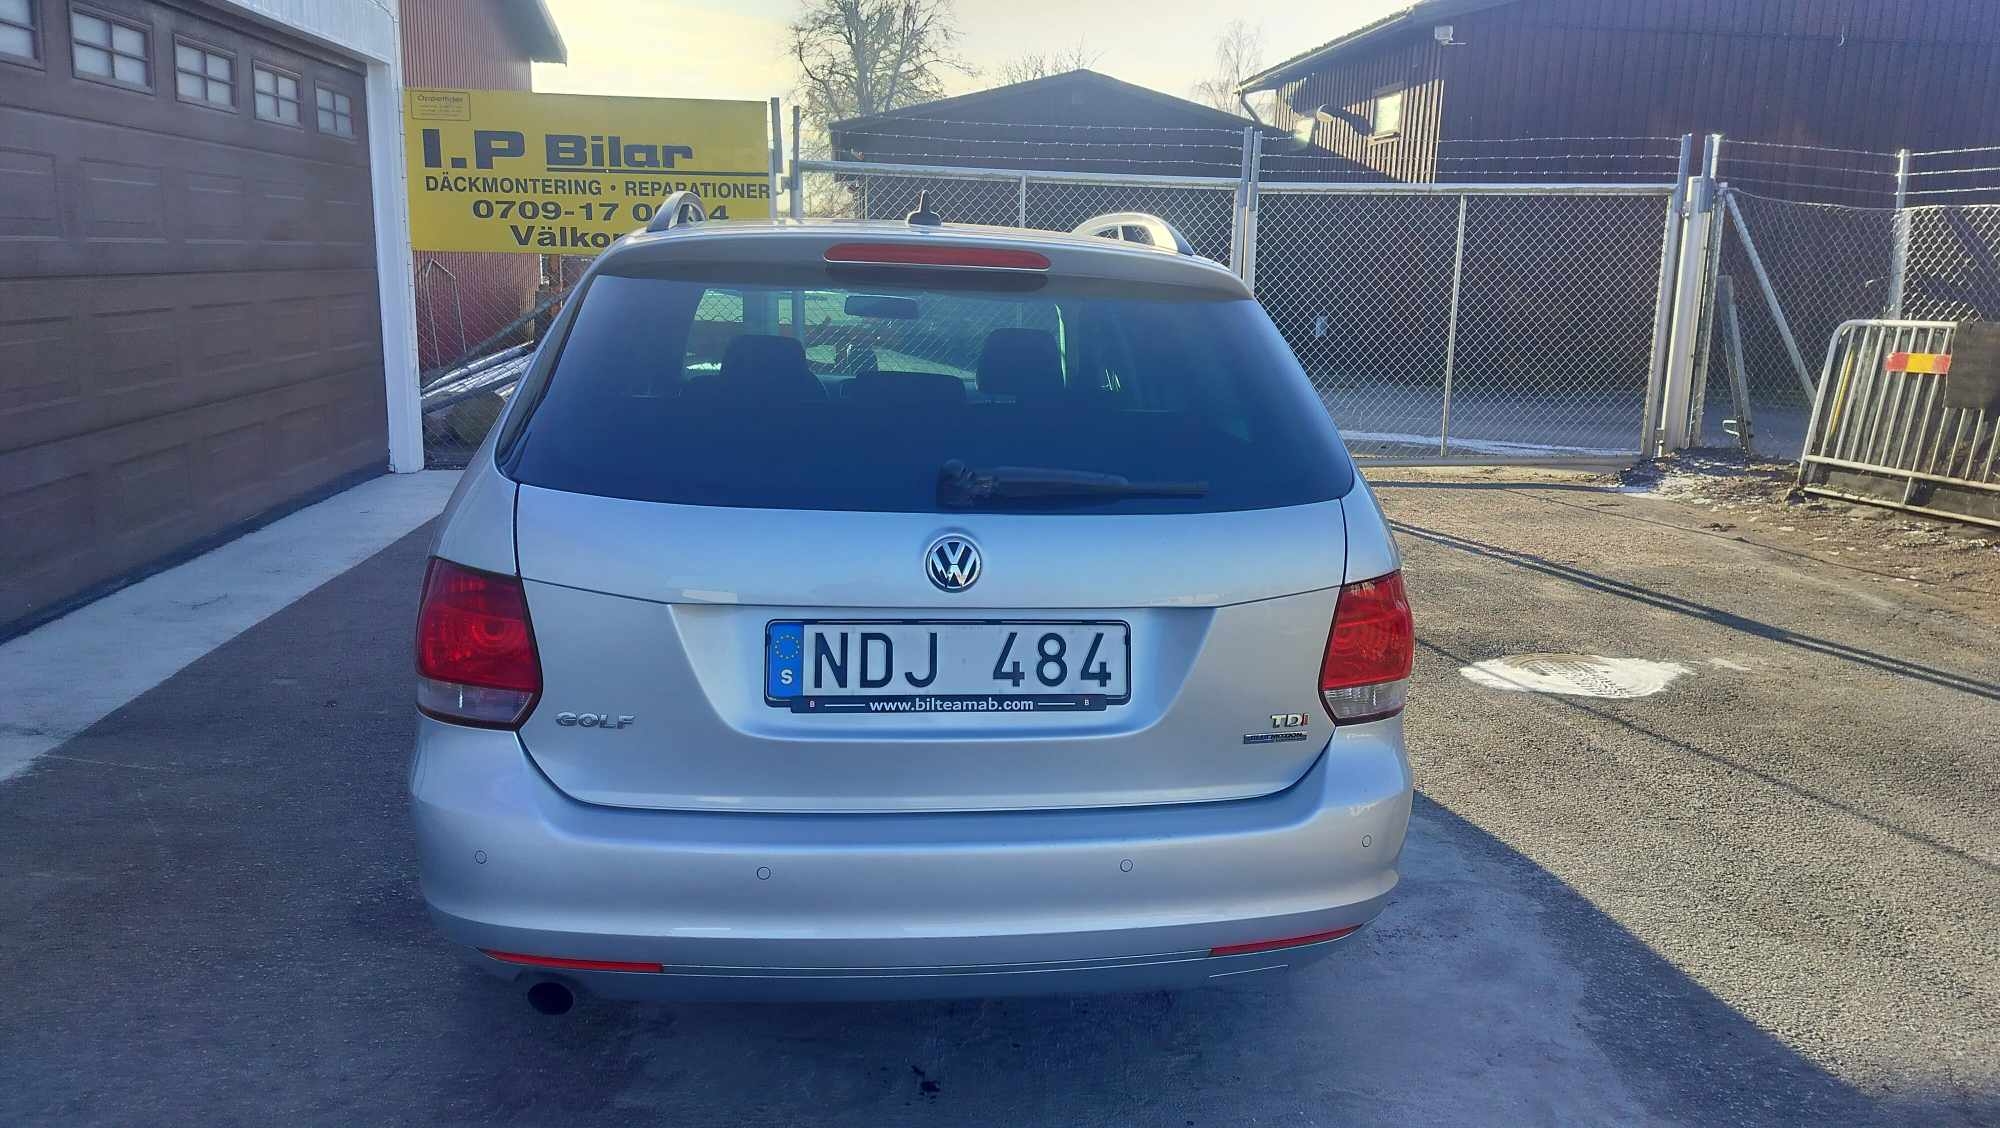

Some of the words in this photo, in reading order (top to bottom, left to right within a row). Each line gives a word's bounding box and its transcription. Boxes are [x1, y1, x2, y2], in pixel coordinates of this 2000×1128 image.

[422, 128, 525, 169] I.P
[545, 134, 693, 168] Bilar
[425, 171, 602, 196] DÄCKMONTERING
[625, 180, 770, 199] REPARATIONER
[472, 200, 619, 222] 0709-17
[814, 632, 938, 688] NDJ
[992, 632, 1112, 688] 484
[780, 669, 793, 685] S
[869, 697, 1034, 712] www.bilteamab.com
[556, 711, 635, 730] GOLF
[1270, 713, 1309, 729] TDI
